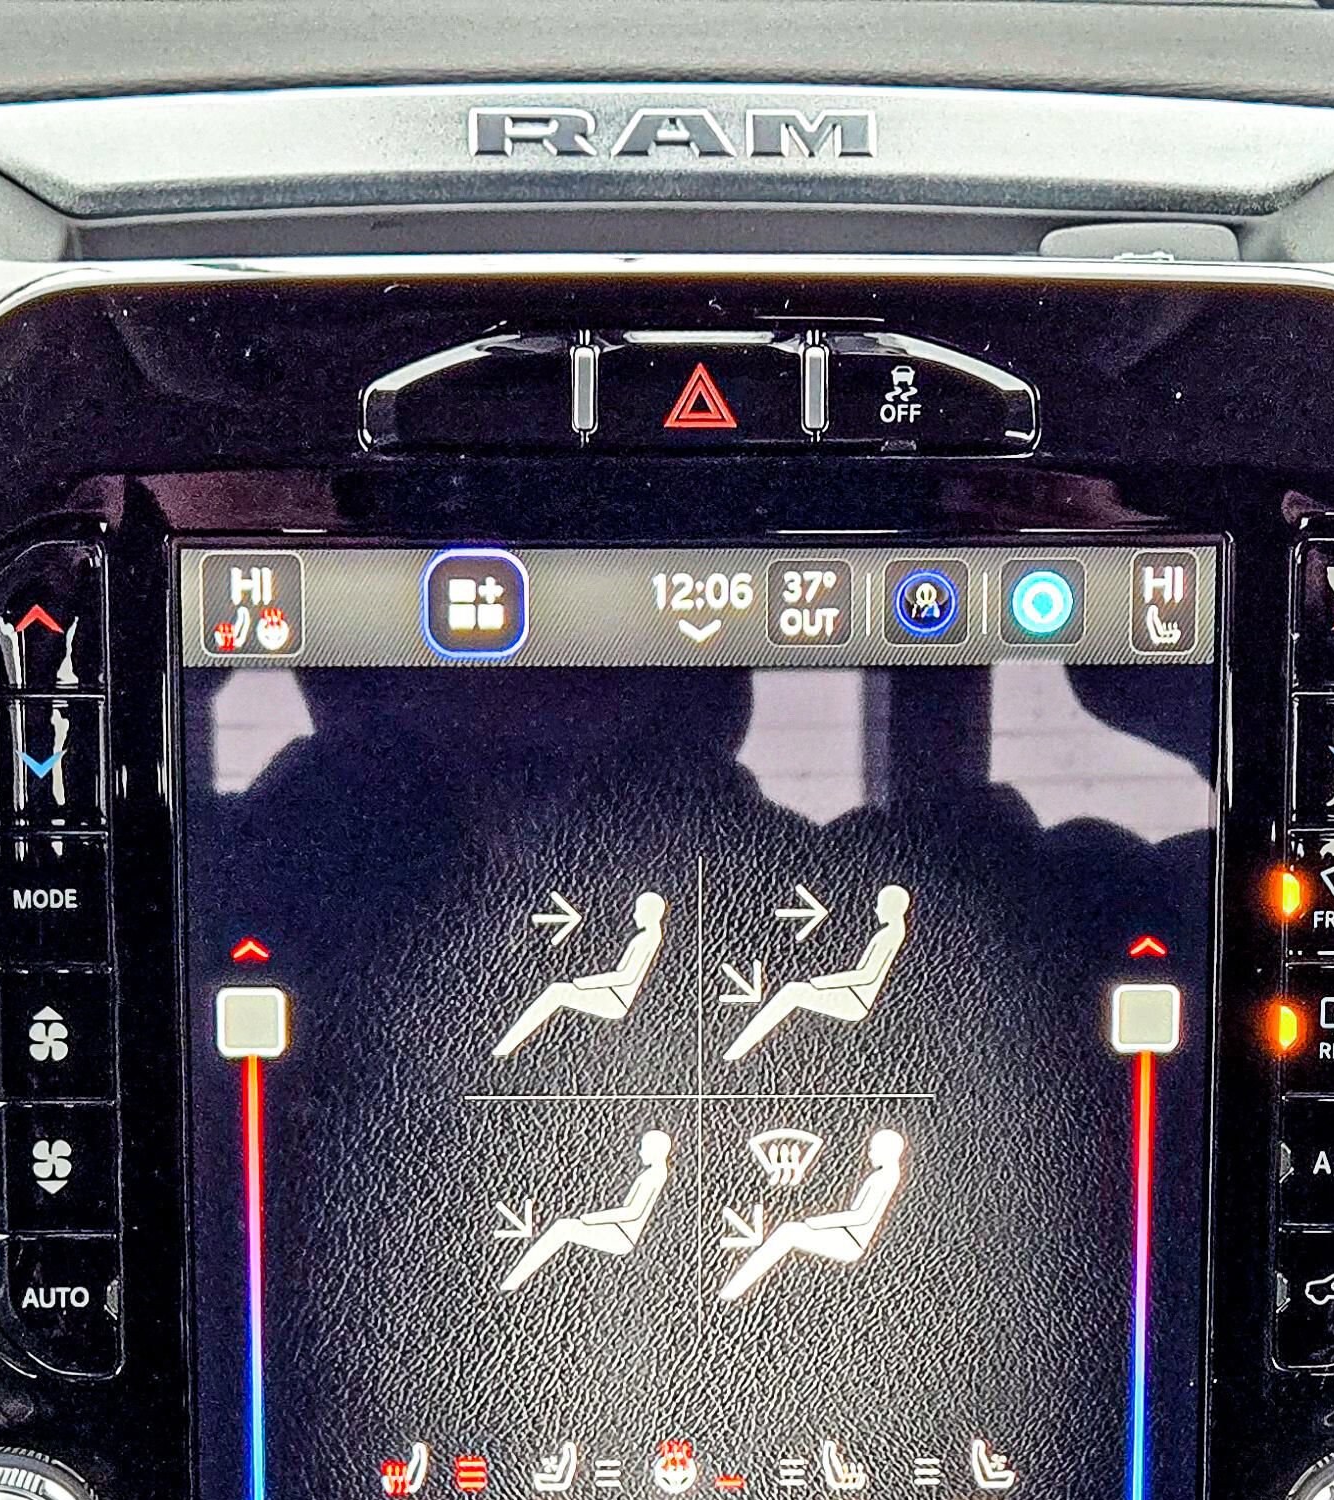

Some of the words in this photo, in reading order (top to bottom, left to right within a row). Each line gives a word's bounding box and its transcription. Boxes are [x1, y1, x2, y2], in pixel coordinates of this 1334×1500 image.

[468, 106, 877, 158] RAM
[879, 403, 922, 425] OFF
[229, 566, 274, 606] HI
[652, 572, 754, 611] 12:06
[782, 570, 837, 603] 37°
[1142, 565, 1186, 603] HI
[779, 608, 840, 637] OUT
[13, 888, 78, 910] MODE
[21, 1286, 90, 1309] AUTO
